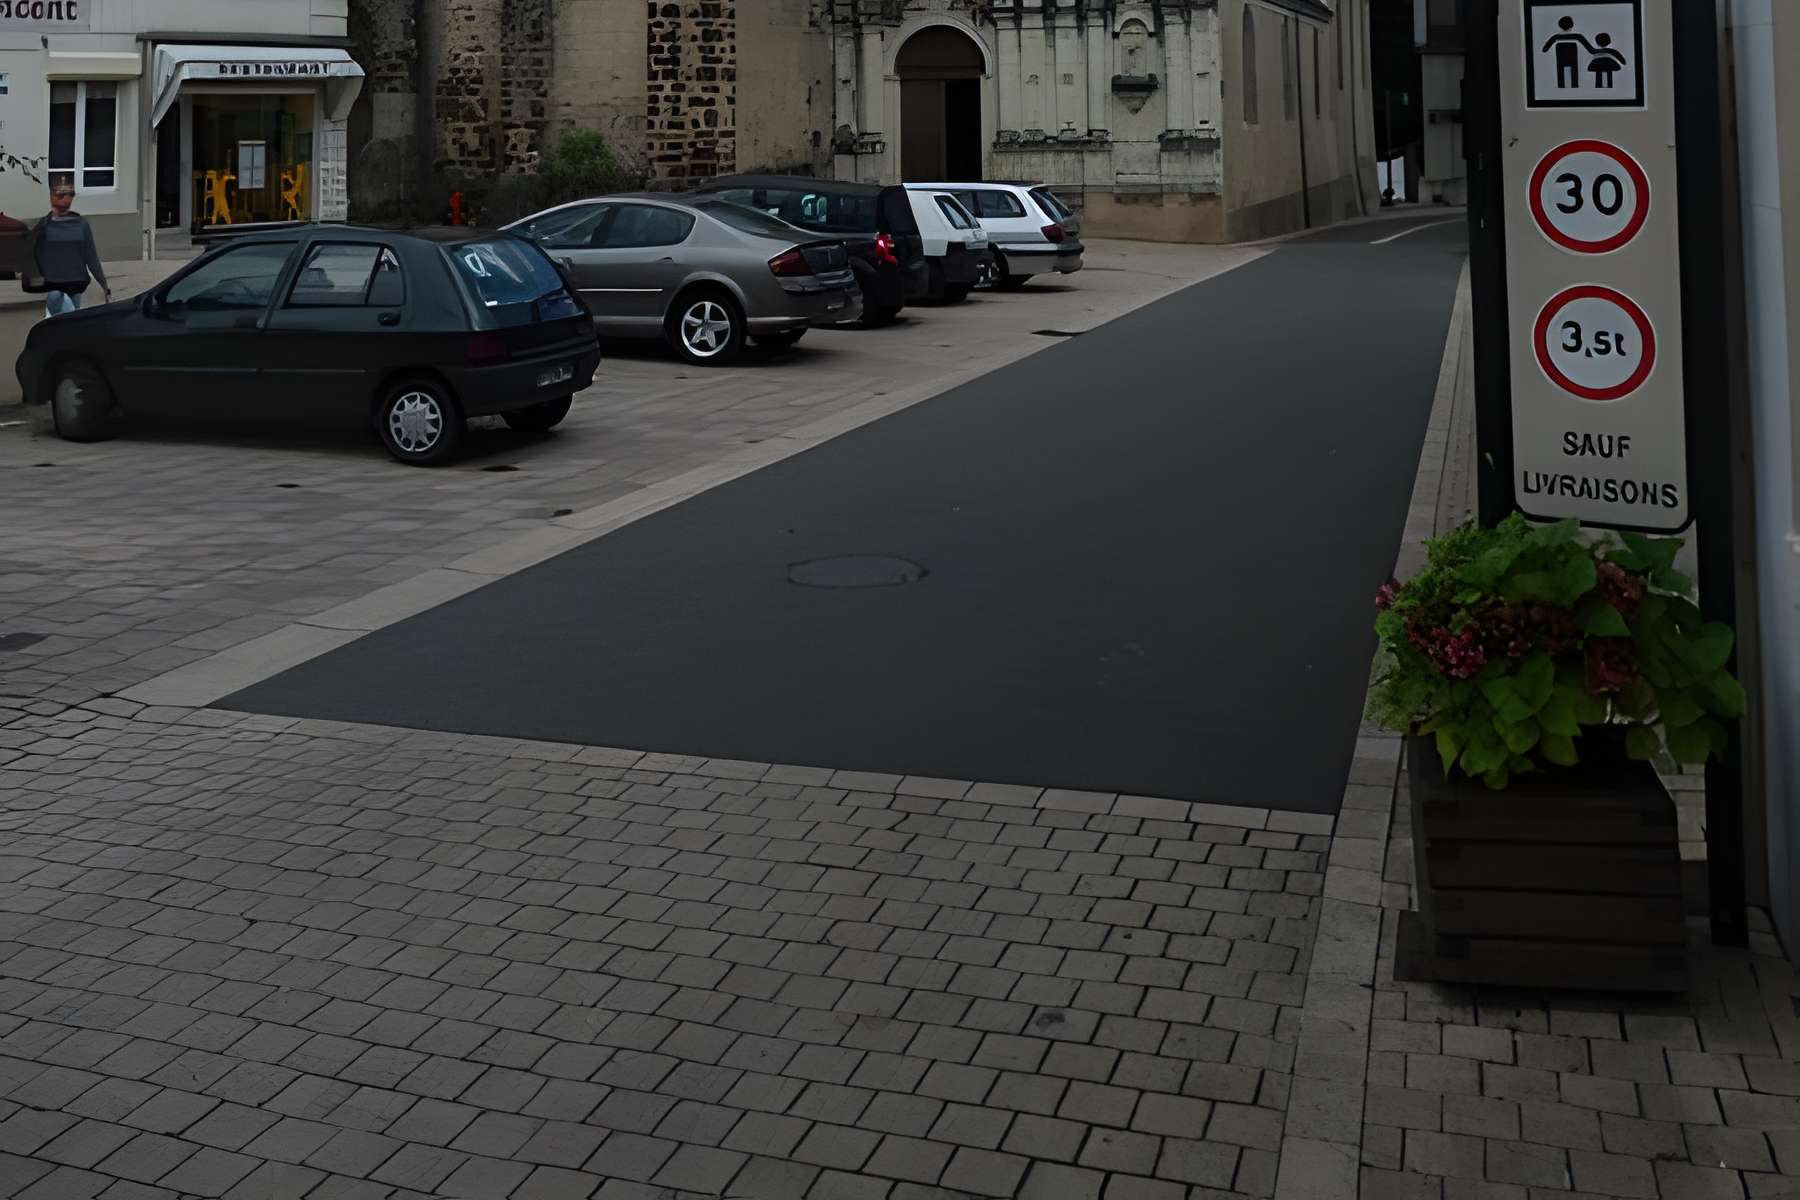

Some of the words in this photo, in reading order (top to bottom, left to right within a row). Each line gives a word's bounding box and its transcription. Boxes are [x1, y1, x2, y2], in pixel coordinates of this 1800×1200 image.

[1555, 173, 1624, 216] 30
[1563, 431, 1631, 458] SAUF
[1523, 470, 1678, 508] LIVRAISONS
